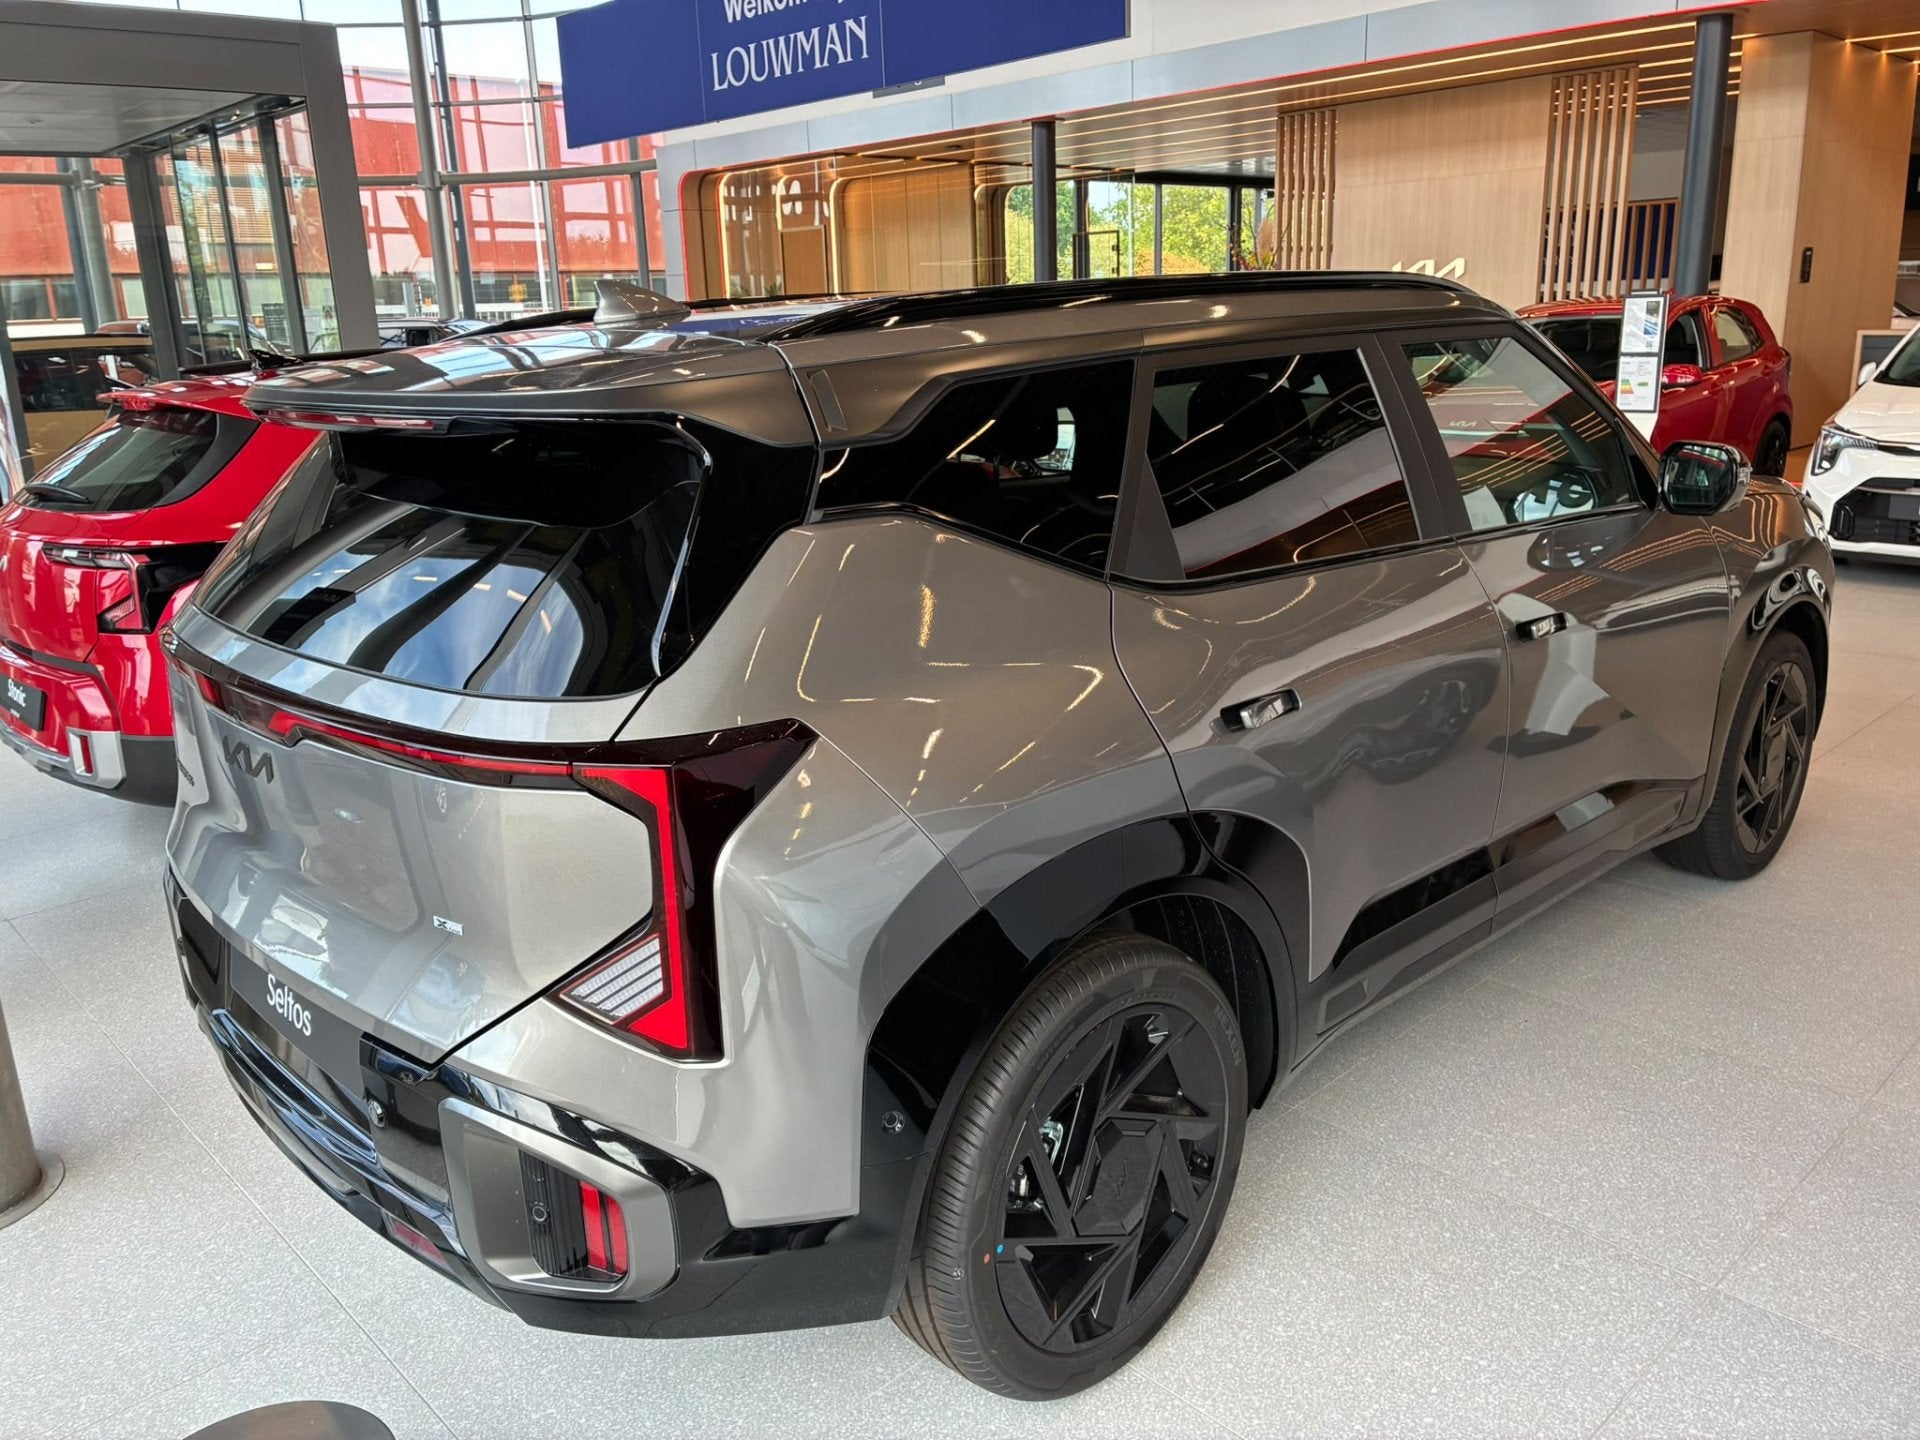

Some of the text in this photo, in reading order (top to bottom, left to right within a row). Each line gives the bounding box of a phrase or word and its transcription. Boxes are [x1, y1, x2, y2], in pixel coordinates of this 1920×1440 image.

[710, 16, 870, 92] LOUWMAN
[7, 678, 26, 707] Stonic
[223, 735, 274, 784] KIA
[266, 974, 312, 1037] Seltos
[1214, 1003, 1242, 1067] NEXEN
